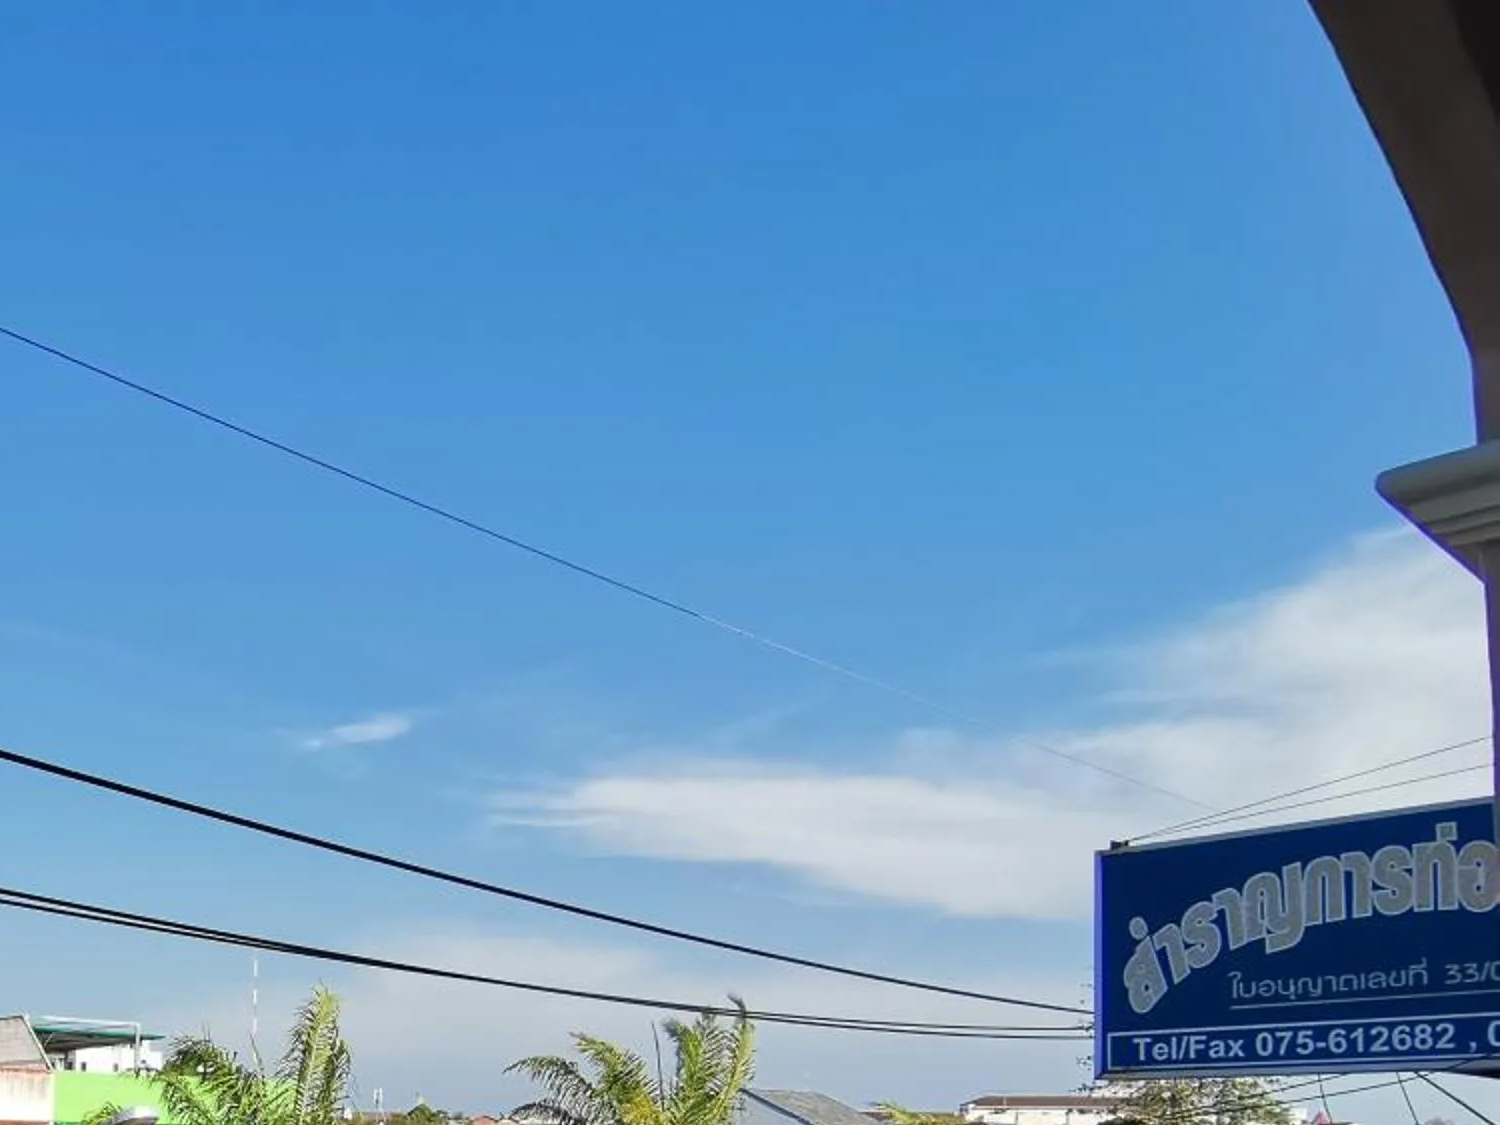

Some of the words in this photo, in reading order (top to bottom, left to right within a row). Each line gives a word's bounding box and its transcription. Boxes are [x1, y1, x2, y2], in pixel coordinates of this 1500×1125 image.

[1228, 957, 1428, 1000] ใบอนุญาตเลขที่
[1133, 1034, 1245, 1062] Tel/Fax
[1255, 1023, 1456, 1057] 075-612682
